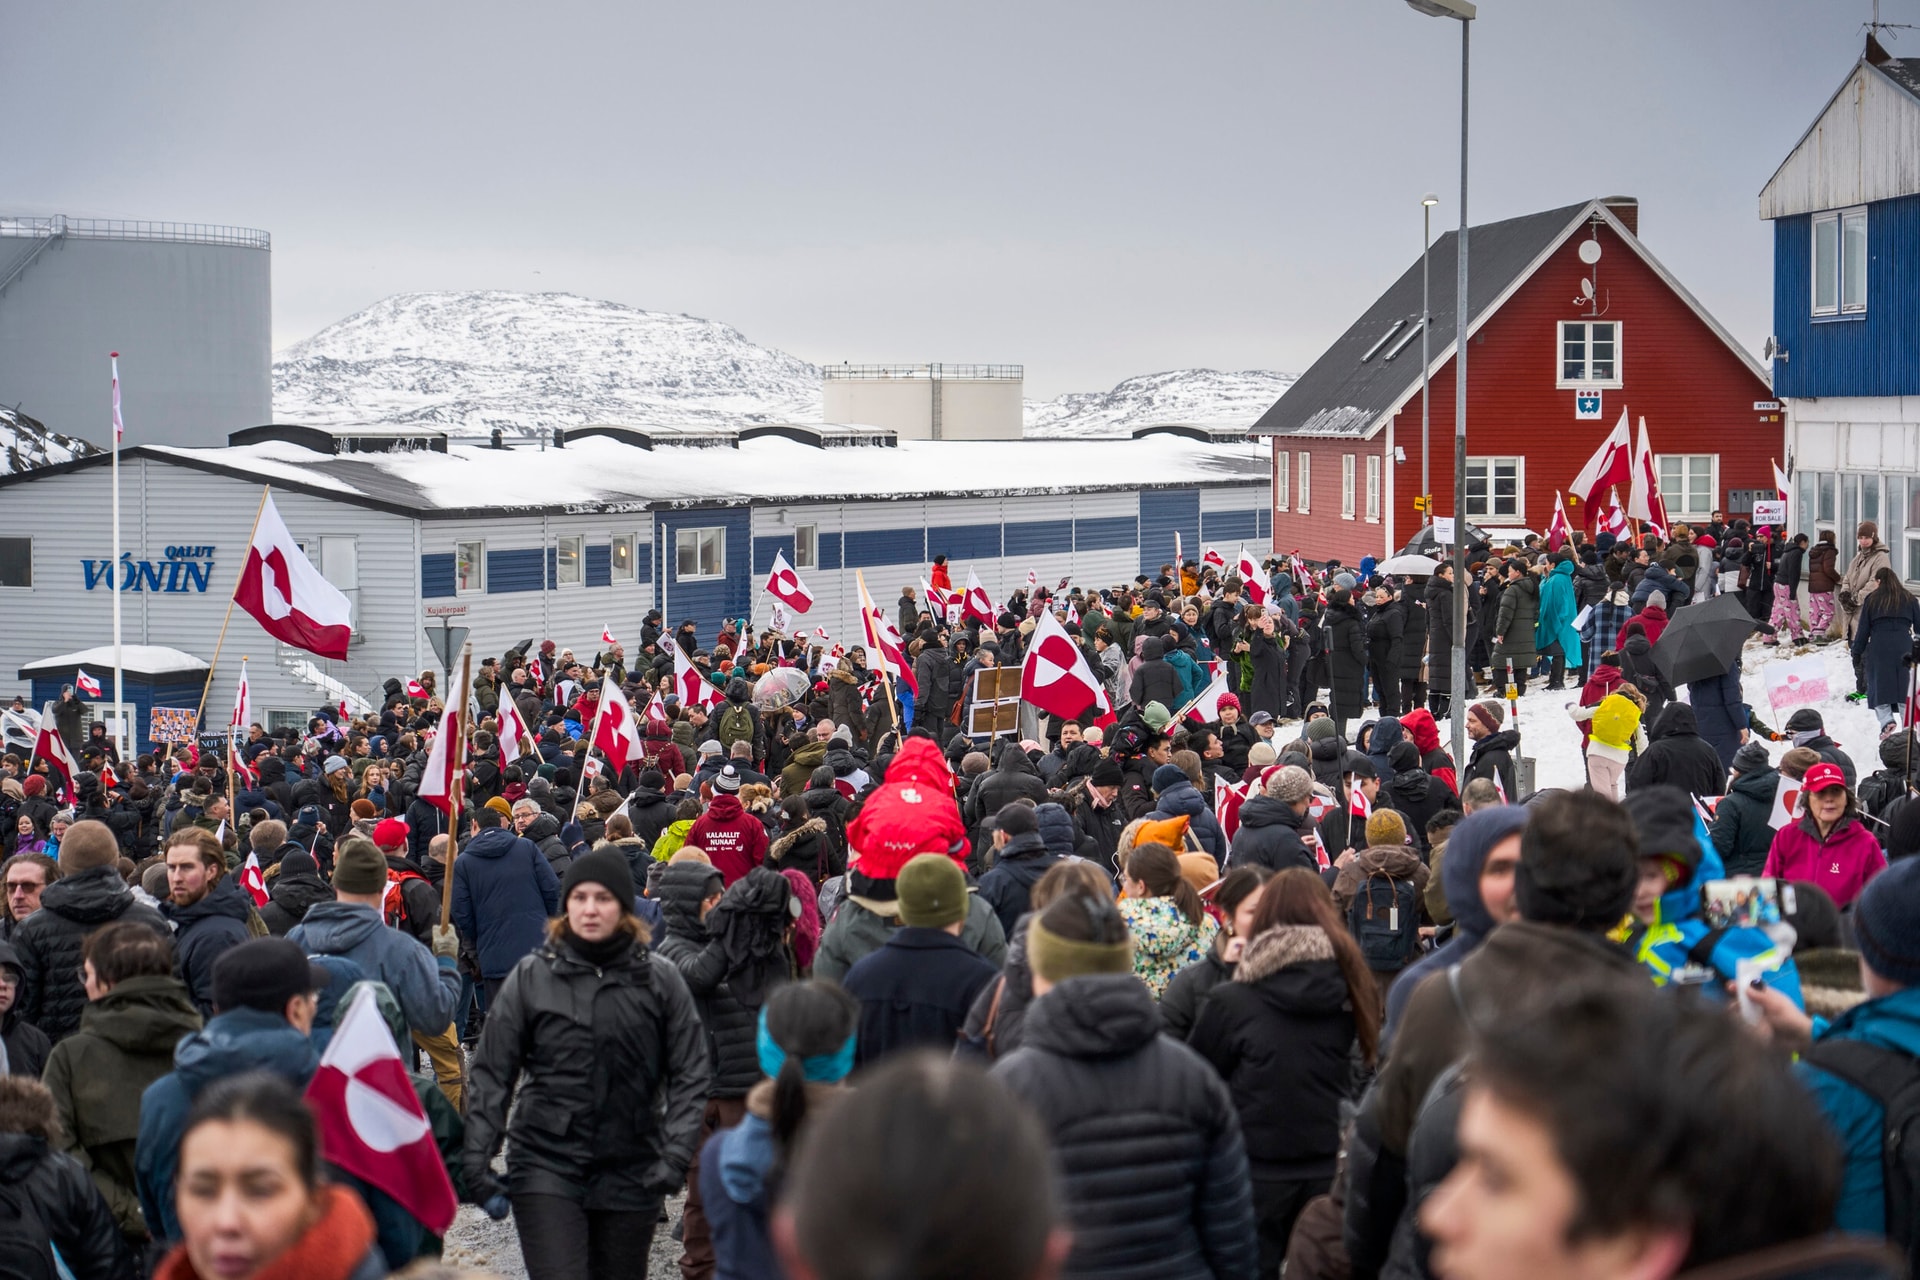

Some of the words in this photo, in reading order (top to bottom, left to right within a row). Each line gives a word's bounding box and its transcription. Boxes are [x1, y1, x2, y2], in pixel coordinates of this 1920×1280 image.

[164, 545, 215, 560] QALUT
[80, 552, 215, 592] VÓNIN
[427, 606, 466, 616] Kujallerpaat
[201, 740, 218, 748] NOT
[706, 831, 740, 839] KALAALLIT
[710, 838, 737, 846] NUNAAT
